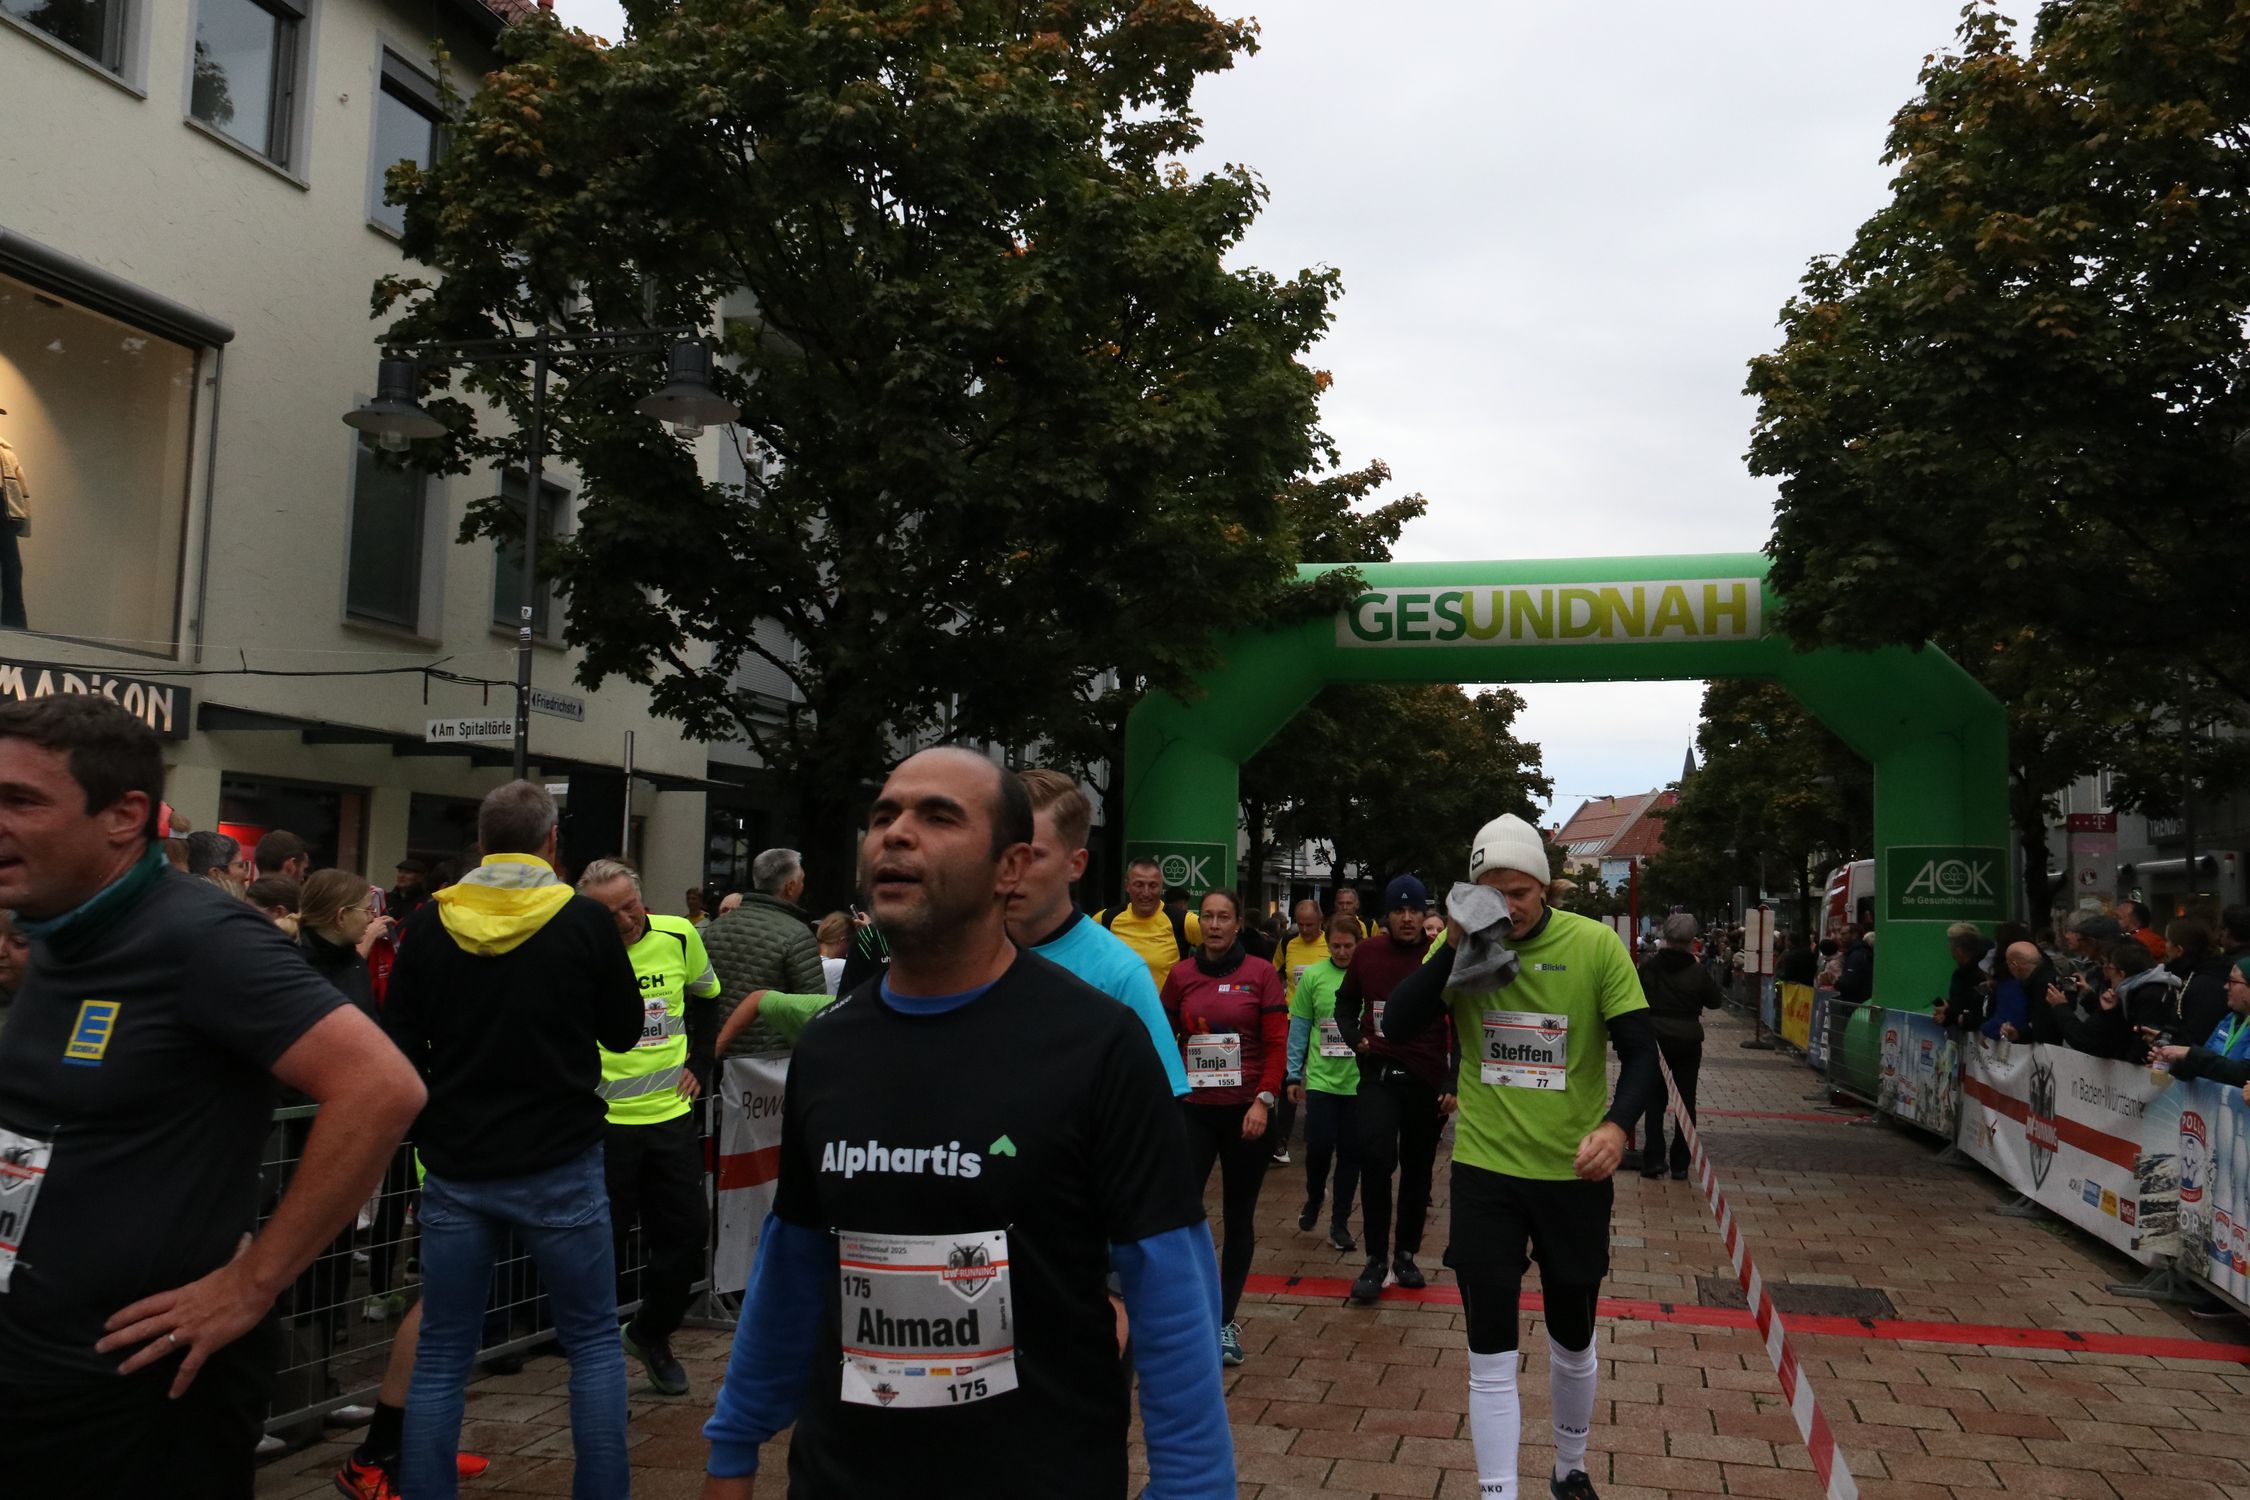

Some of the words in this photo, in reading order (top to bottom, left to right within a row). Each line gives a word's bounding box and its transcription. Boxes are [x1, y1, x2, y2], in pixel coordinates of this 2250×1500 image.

[1348, 583, 1747, 642] GESUNDNAH
[536, 692, 577, 714] Friedrichstr.
[439, 722, 455, 736] Am
[459, 720, 512, 739] Spitaltörle
[1152, 854, 1211, 888] OK
[1904, 859, 1994, 895] AOK
[1902, 896, 1915, 905] Die
[75, 1005, 114, 1044] E
[1484, 1029, 1496, 1038] 77
[1188, 1048, 1202, 1056] 1555
[1490, 1042, 1553, 1063] Steffen
[1195, 1057, 1227, 1071] Tanja
[1536, 1079, 1549, 1088] 77
[820, 1139, 982, 1179] Alphartis
[943, 1266, 997, 1279] BW-RUNNING
[843, 1275, 871, 1299] 175
[856, 1306, 981, 1348] Ahmad
[947, 1377, 989, 1402] 175
[1559, 1423, 1588, 1434] JAKO
[1479, 1484, 1503, 1493] AKO
